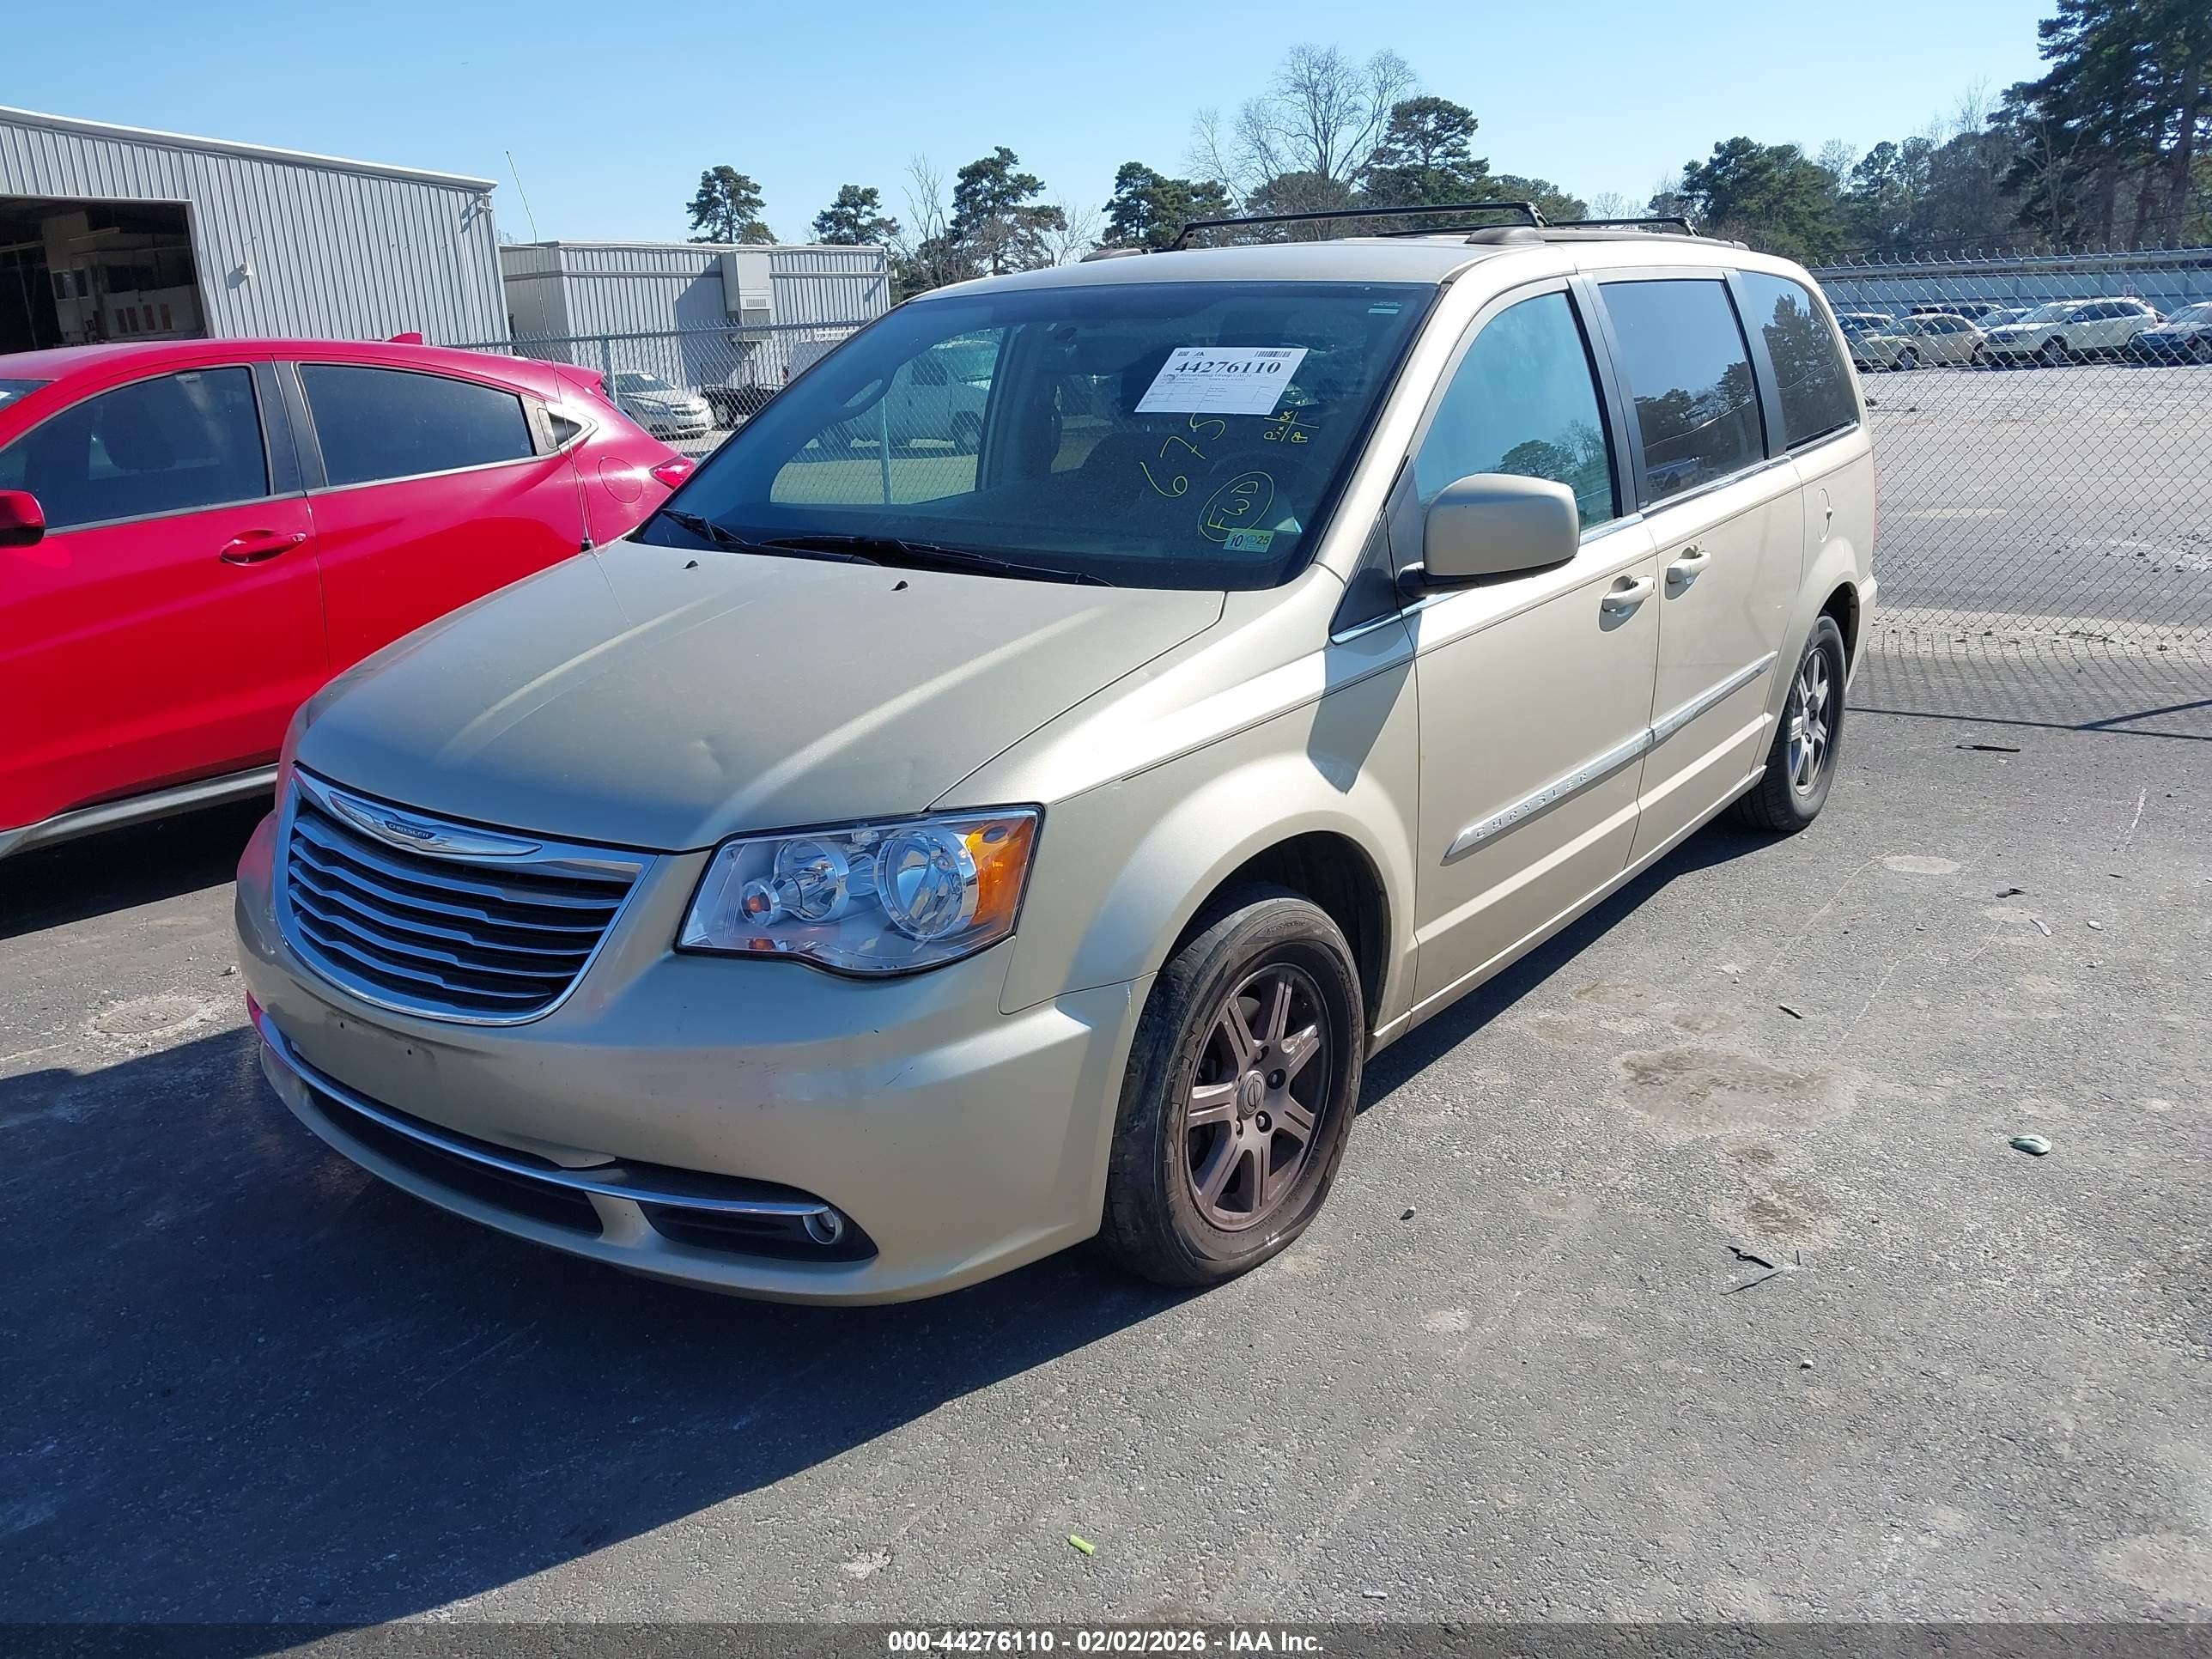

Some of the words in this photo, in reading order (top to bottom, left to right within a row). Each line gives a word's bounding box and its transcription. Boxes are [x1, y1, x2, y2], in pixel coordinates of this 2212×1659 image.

[1175, 361, 1281, 374] 44276110
[1230, 534, 1244, 547] 10
[1255, 535, 1271, 545] 25
[1475, 773, 1588, 838] CHRYSLER
[388, 823, 429, 838] CHRYSLER
